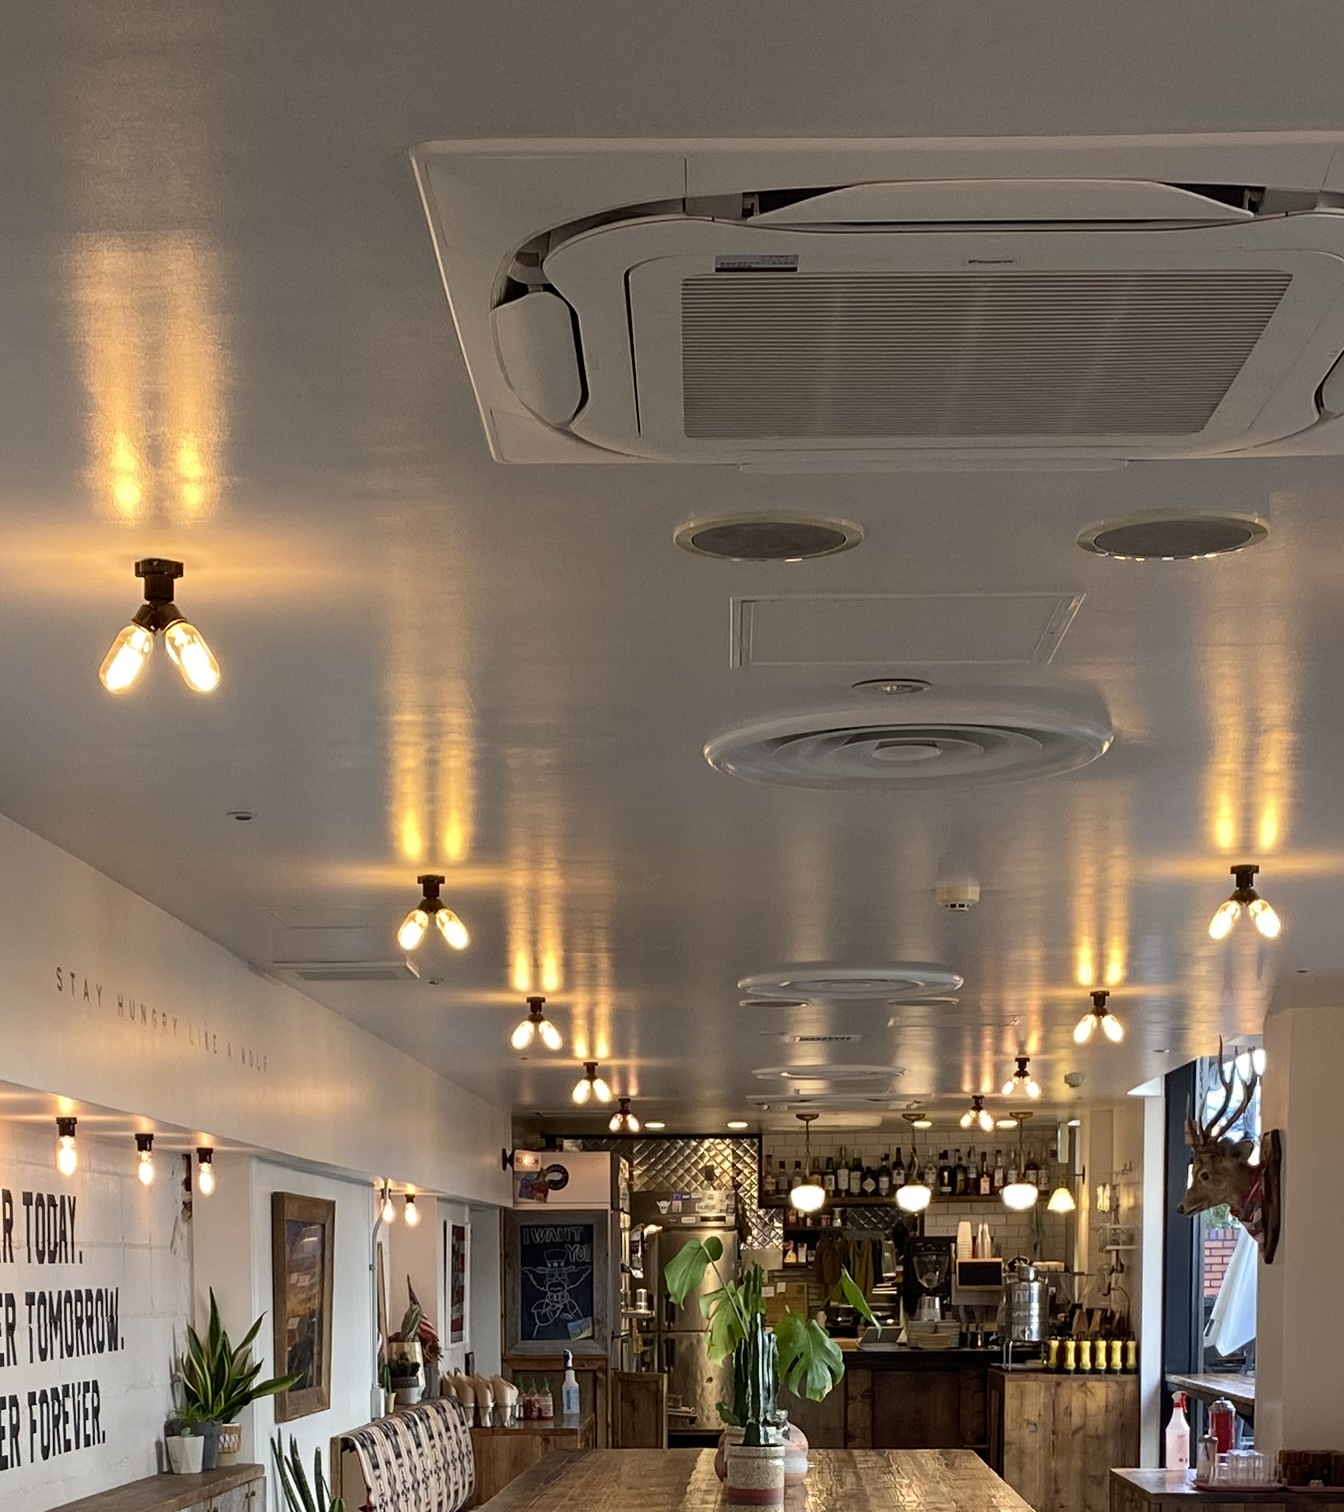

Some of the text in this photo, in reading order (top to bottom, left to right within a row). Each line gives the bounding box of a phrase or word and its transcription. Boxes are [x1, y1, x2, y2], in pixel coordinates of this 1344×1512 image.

[56, 966, 268, 1074] STAY HUNGRY LIKE A WOLF
[22, 1190, 83, 1265] TODAY.
[523, 1226, 583, 1245] I WANT
[25, 1287, 125, 1364] TOMORROW.
[27, 1379, 106, 1463] FOREVER.
